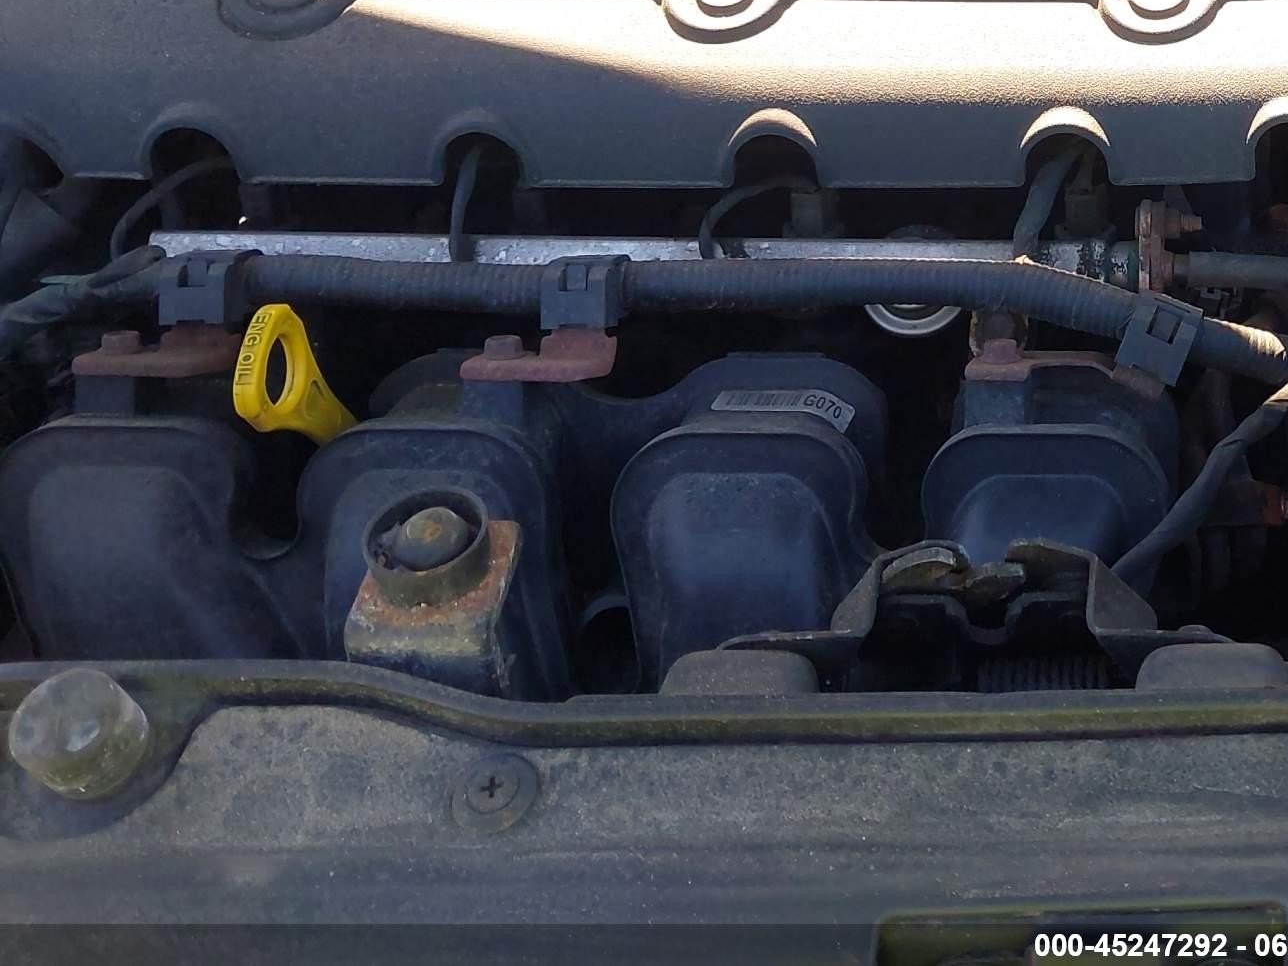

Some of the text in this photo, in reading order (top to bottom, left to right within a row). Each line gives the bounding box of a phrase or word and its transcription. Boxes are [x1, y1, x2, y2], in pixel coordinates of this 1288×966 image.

[235, 313, 271, 382] ENG OIL
[803, 394, 842, 419] G070
